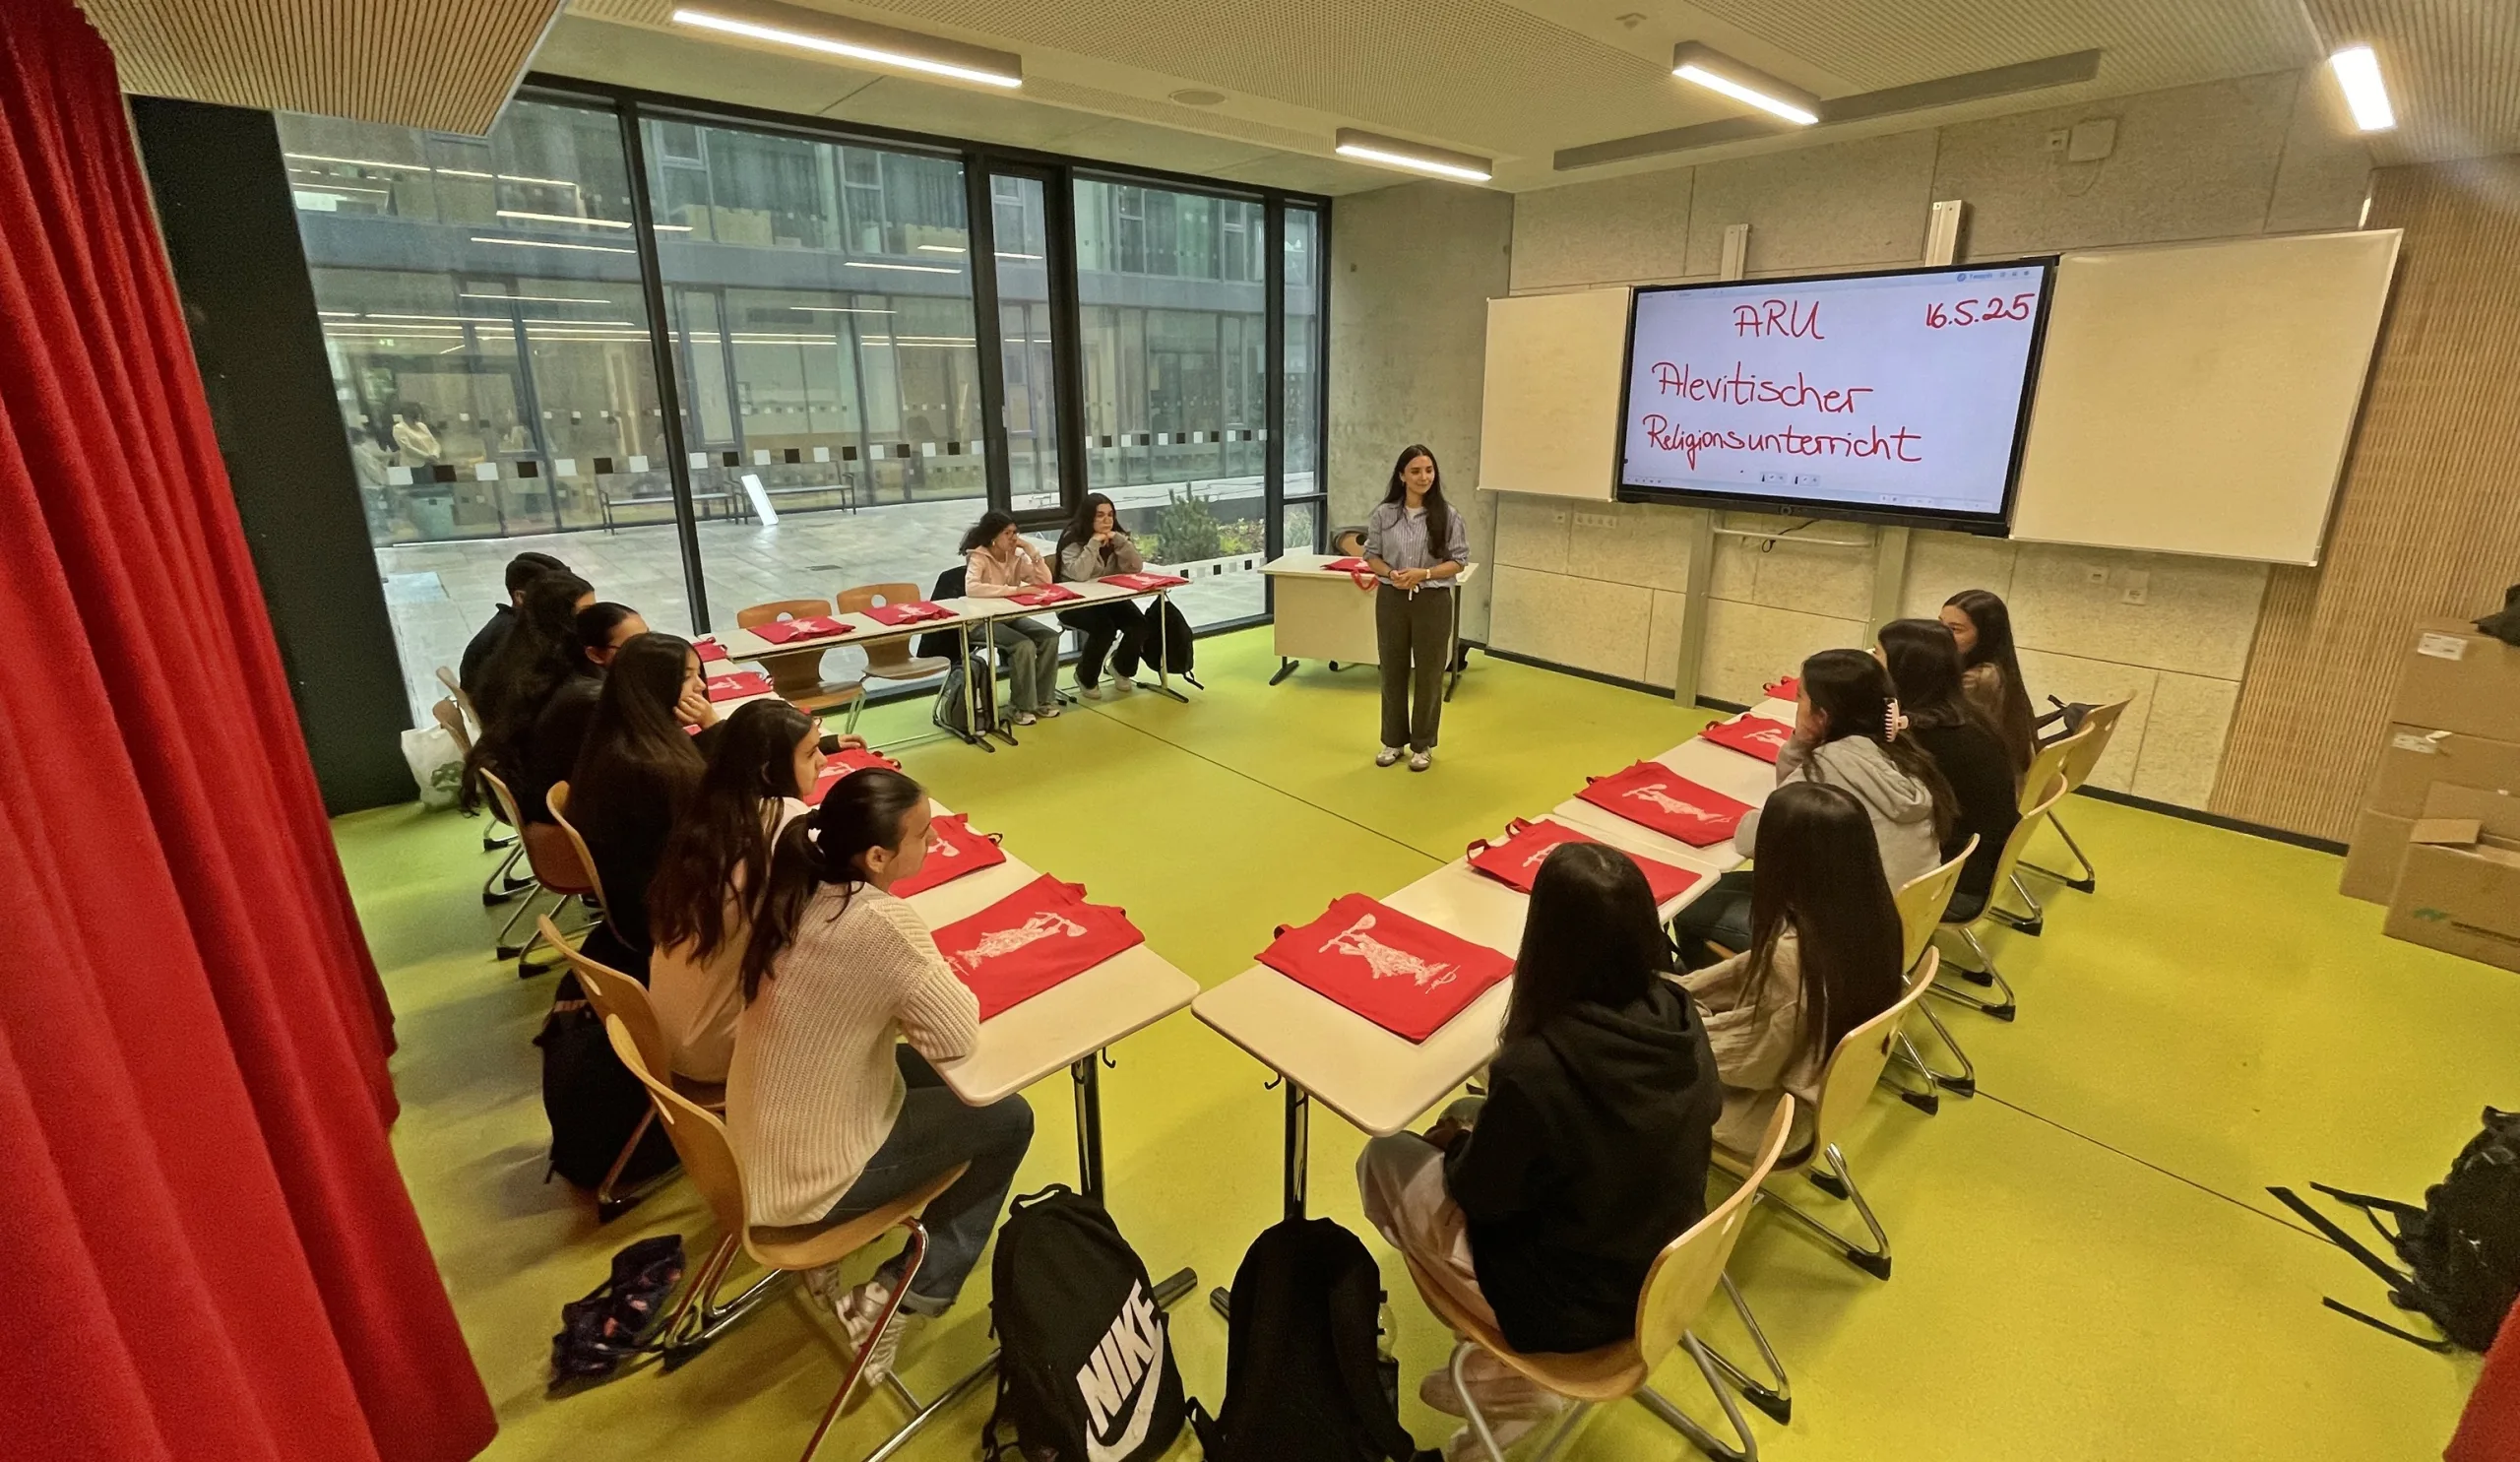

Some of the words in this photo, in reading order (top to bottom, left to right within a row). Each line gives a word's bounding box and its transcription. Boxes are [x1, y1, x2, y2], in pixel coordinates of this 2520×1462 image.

[1732, 299, 1825, 340] ARU
[1925, 293, 2035, 329] 16.5.25
[1652, 361, 1873, 413] Alevitischer
[1643, 414, 1922, 471] Religionsunterricht
[1076, 1278, 1156, 1438] NIKE
